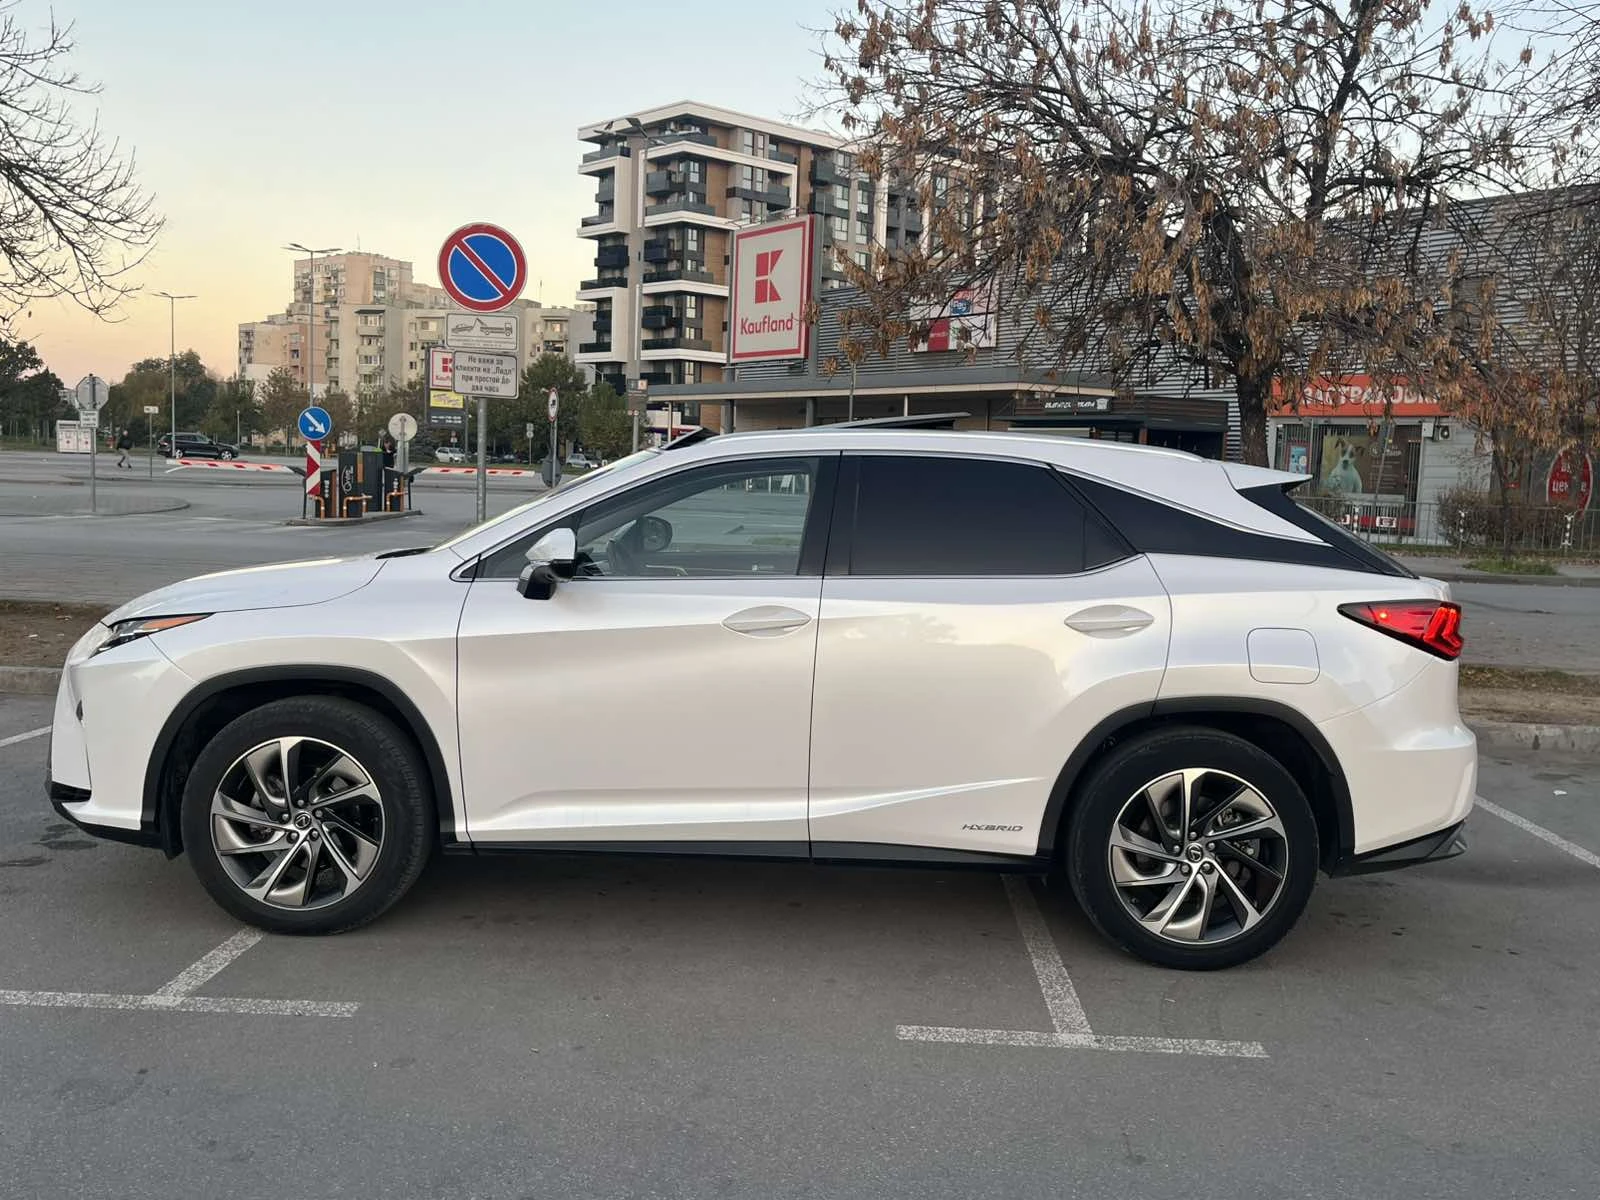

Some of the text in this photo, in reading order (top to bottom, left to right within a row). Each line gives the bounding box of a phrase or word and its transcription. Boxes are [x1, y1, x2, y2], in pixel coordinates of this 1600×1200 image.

[740, 312, 794, 335] Kaufland
[468, 355, 476, 363] Не
[462, 374, 473, 382] при
[471, 384, 499, 393] два часа
[962, 824, 1023, 832] HYBRID
